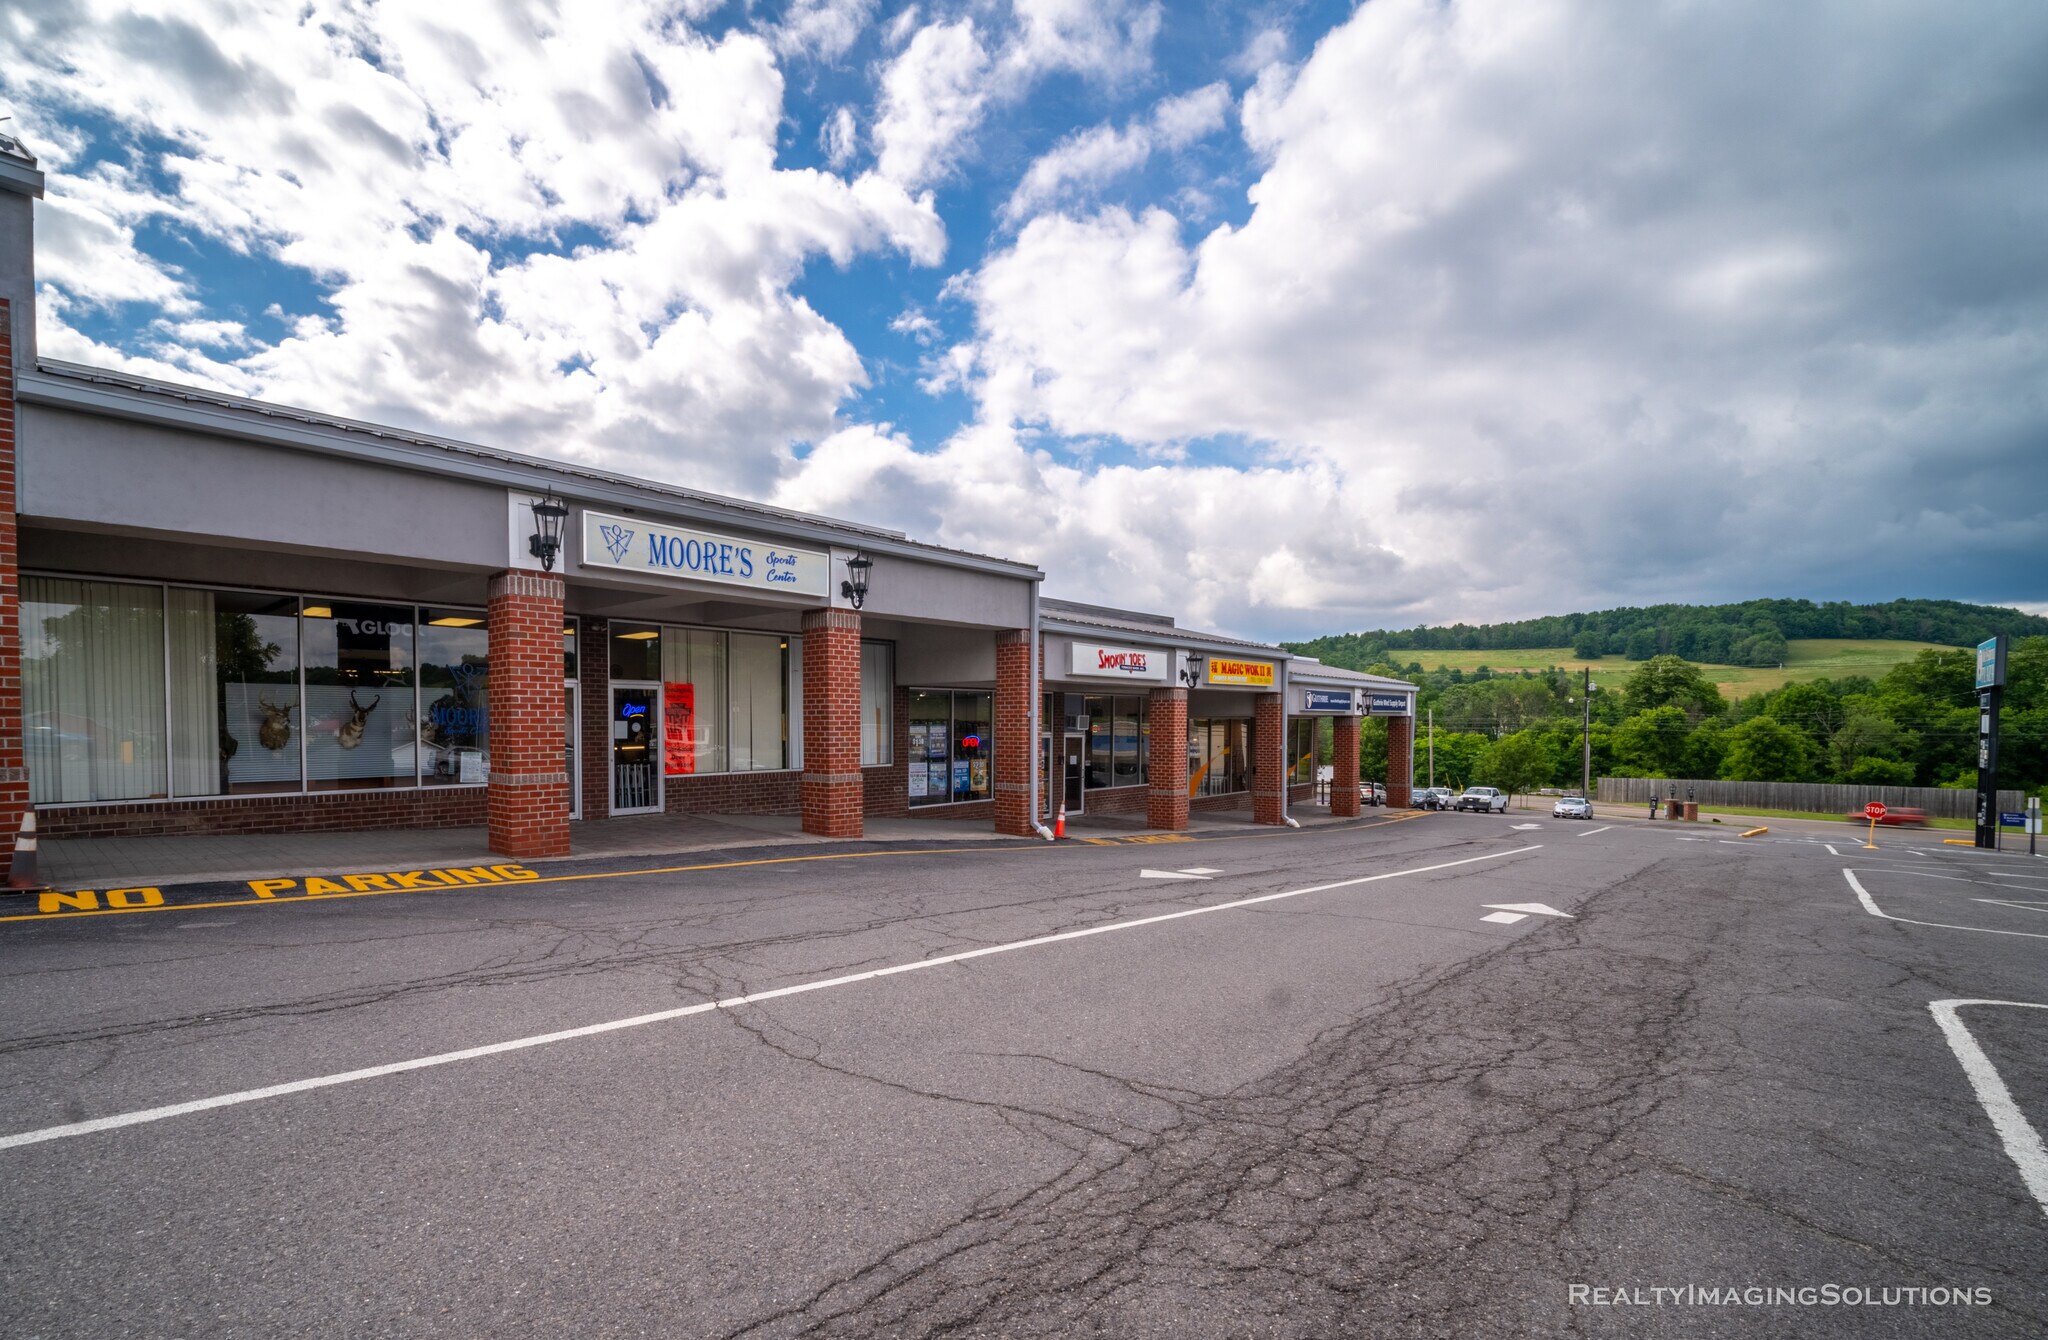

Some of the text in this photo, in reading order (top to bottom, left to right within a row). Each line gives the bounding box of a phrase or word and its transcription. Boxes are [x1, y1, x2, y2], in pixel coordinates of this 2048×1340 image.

[648, 533, 753, 578] MOORE'S
[766, 551, 798, 567] Sports
[766, 568, 797, 583] Center
[1221, 662, 1244, 675] MAGIC
[1245, 664, 1259, 676] WOK
[622, 703, 646, 717] Open
[1865, 806, 1886, 814] STOP
[39, 864, 540, 913] NO PARKING
